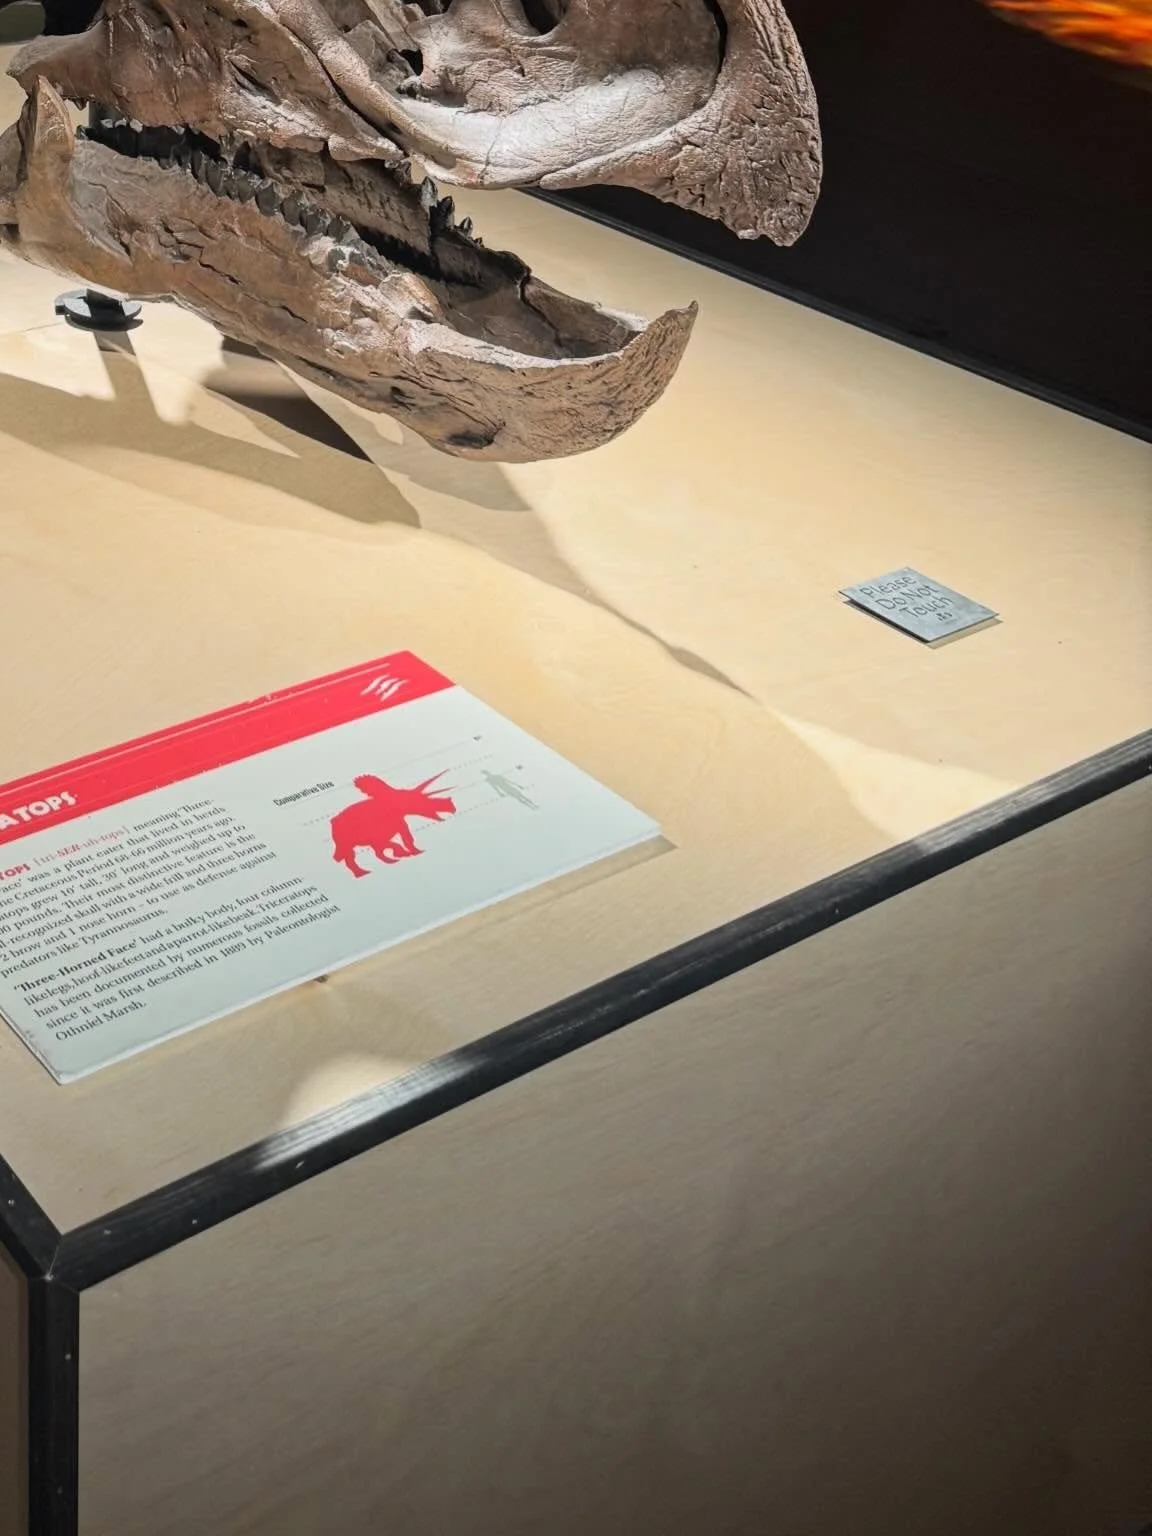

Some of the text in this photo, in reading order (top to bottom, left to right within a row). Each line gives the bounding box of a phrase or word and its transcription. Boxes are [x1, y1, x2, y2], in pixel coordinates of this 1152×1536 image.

[859, 576, 917, 598] Please
[875, 585, 939, 610] Do Not
[899, 596, 953, 618] Touch
[133, 811, 181, 832] meaning
[273, 781, 334, 806] Comparative Size
[13, 908, 62, 930] pounds.
[61, 894, 93, 909] Their
[96, 882, 125, 897] most
[127, 861, 184, 885] distinctive
[184, 846, 224, 863] feature
[236, 834, 255, 844] the
[14, 874, 78, 900] Cretaceous
[76, 858, 114, 877] Period
[146, 835, 185, 852] million
[184, 824, 213, 838] years
[27, 872, 51, 882] was
[64, 855, 94, 871] plant
[96, 844, 124, 857] eater
[126, 834, 150, 846] that
[149, 822, 179, 837] lived
[192, 807, 226, 821] herds
[30, 894, 58, 910] grew
[79, 878, 102, 890] tall,
[120, 861, 149, 874] long
[148, 851, 170, 864] and
[171, 834, 216, 855] weighed
[216, 829, 232, 838] up
[74, 903, 101, 919] skull
[101, 895, 128, 908] with
[136, 882, 164, 895] wide
[163, 872, 184, 885] frill
[184, 864, 206, 877] and
[206, 855, 235, 868] three
[233, 843, 266, 858] horns
[9, 942, 40, 958] brow
[43, 930, 67, 945] and
[78, 917, 106, 931] nose
[105, 906, 136, 920] horn
[160, 889, 180, 900] use
[196, 867, 238, 886] defense
[239, 851, 277, 870] against
[139, 930, 164, 944] had
[171, 915, 205, 931] bulky
[204, 904, 237, 918] body,
[235, 894, 259, 906] four
[0, 951, 57, 978] predators
[56, 942, 79, 954] like
[24, 992, 48, 1006] like
[45, 983, 75, 997] legs,
[71, 962, 125, 986] hoof-like
[122, 953, 146, 966] feet
[144, 943, 167, 958] and
[172, 920, 231, 948] parrot-like
[256, 886, 317, 912] Triceratops
[33, 894, 328, 1017] has been documented by numerous fossils collected
[46, 905, 341, 1029] since it was first described in 1889 by Paleontologist
[55, 1001, 146, 1040] Othniel Marsh.
